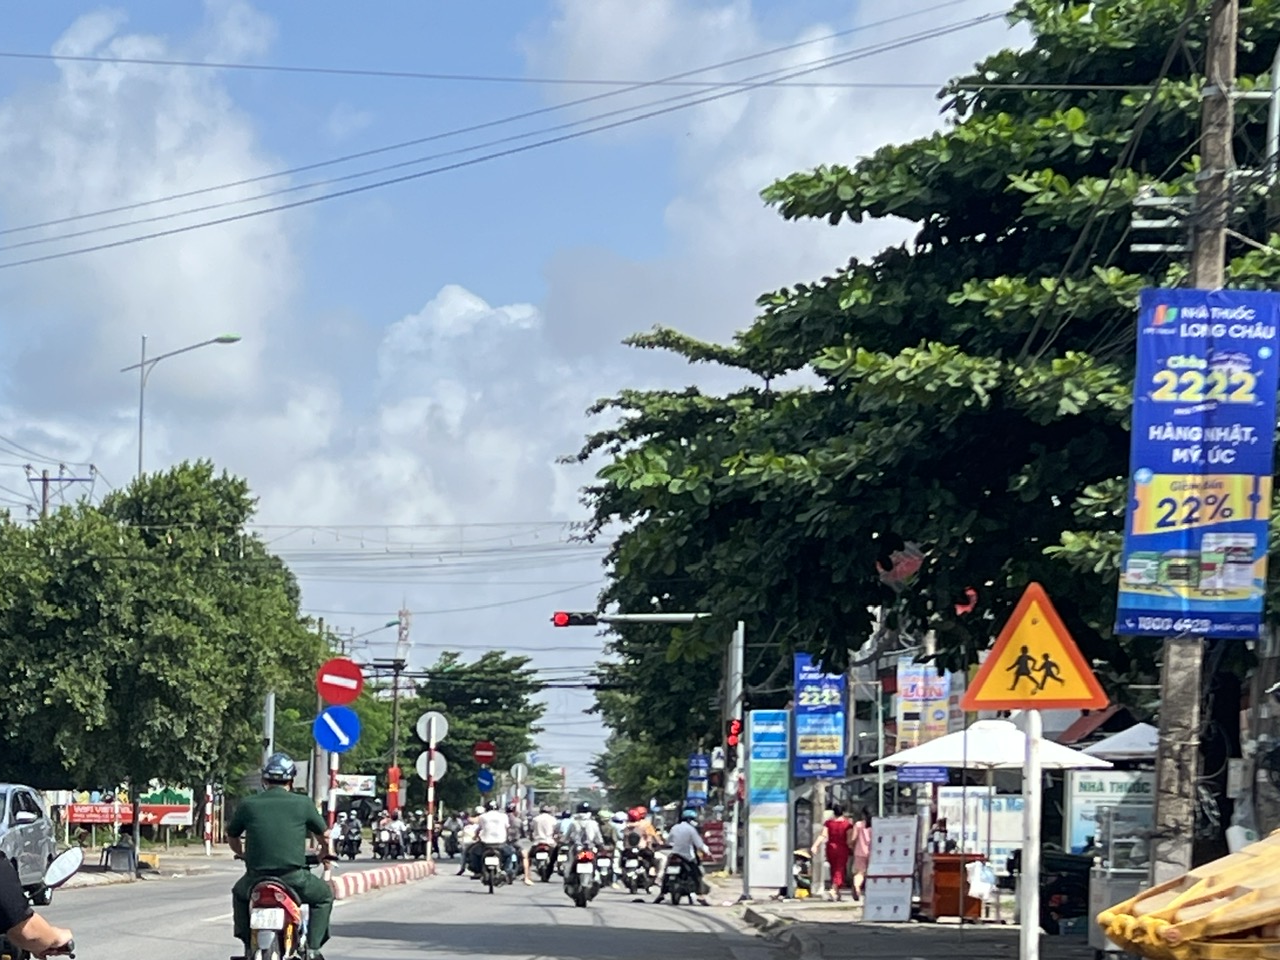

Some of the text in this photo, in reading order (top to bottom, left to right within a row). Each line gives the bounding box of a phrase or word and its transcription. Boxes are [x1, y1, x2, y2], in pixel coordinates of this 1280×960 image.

[1180, 304, 1256, 321] NHÀ THUỐC
[1179, 323, 1227, 338] LONG
[1228, 322, 1277, 339] CHÂU
[1151, 369, 1257, 403] 2222
[1148, 421, 1203, 441] HÀNG
[1207, 444, 1238, 465] ÚC
[1155, 493, 1234, 529] 22%
[799, 690, 842, 706] 2222
[1078, 779, 1105, 793] NHÀ
